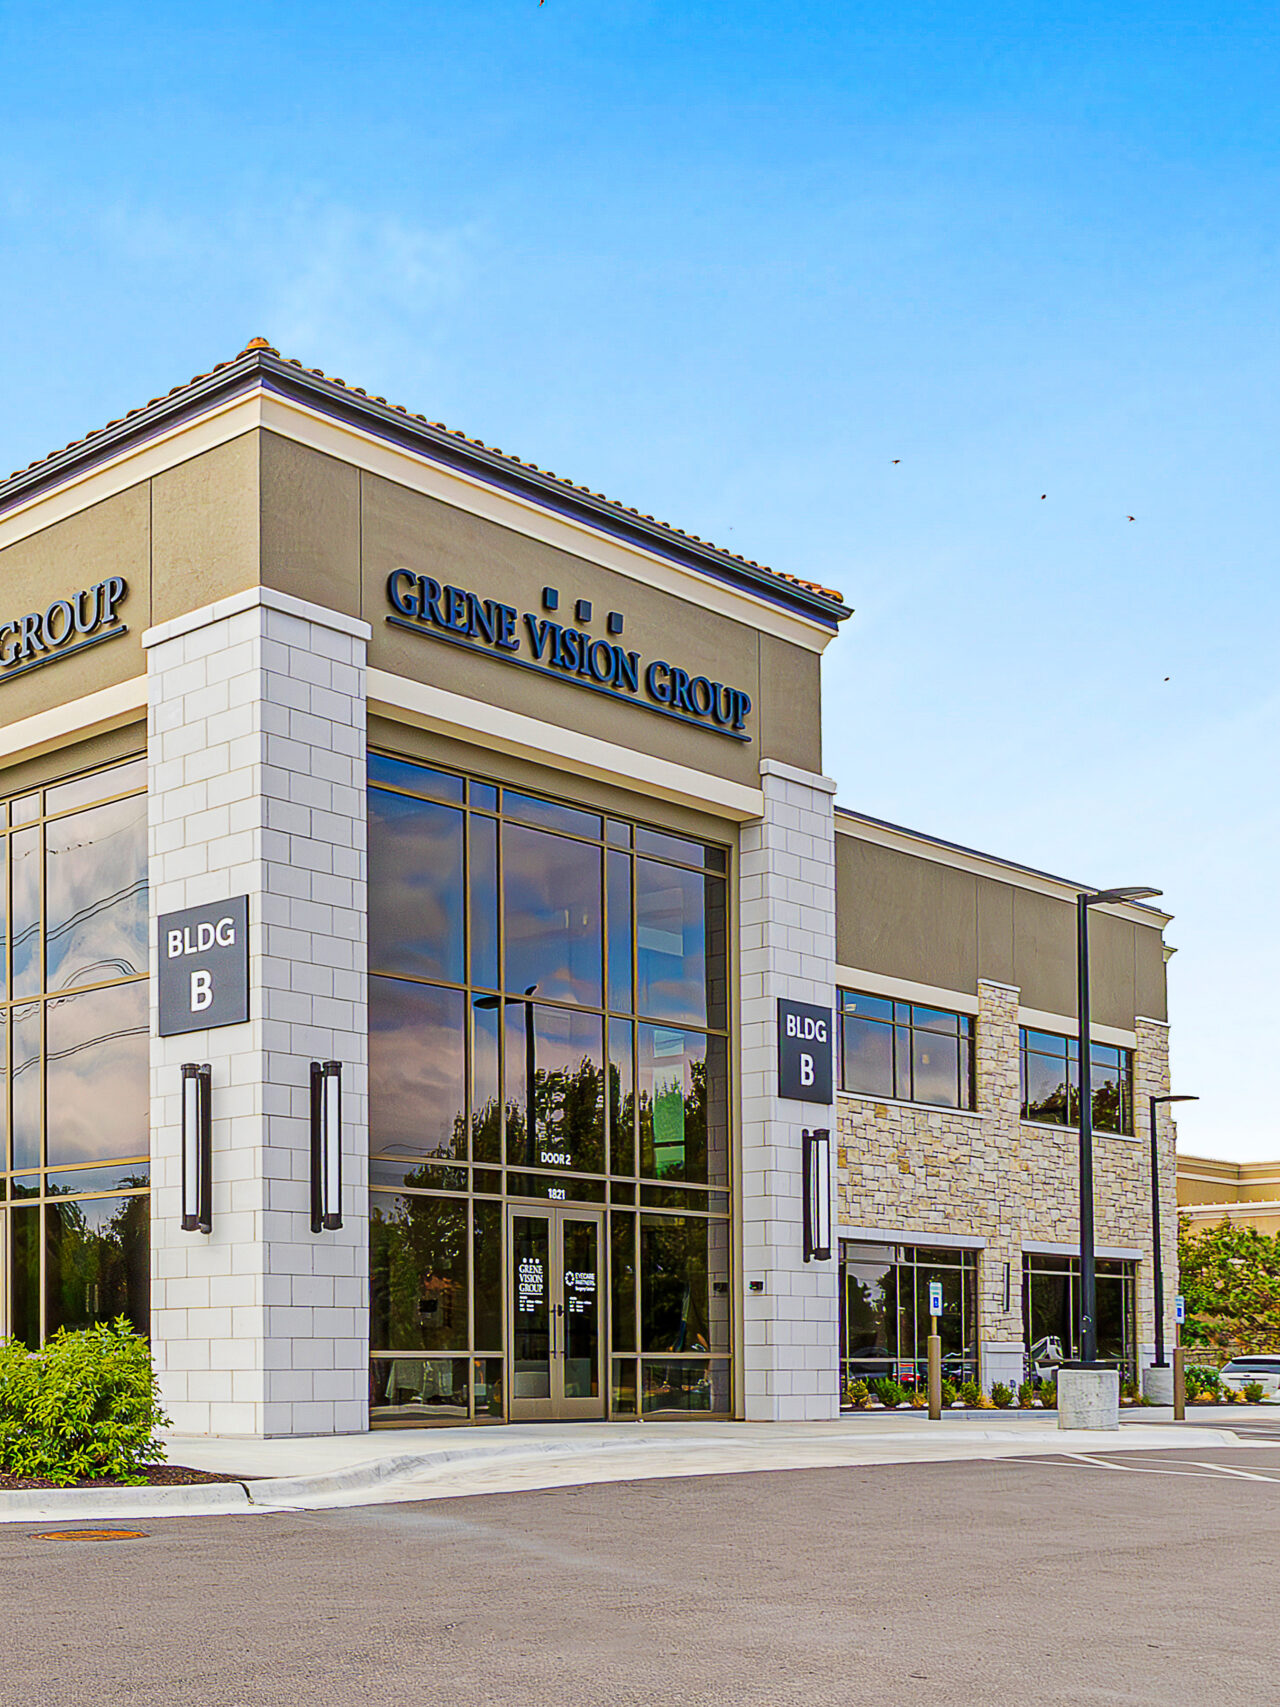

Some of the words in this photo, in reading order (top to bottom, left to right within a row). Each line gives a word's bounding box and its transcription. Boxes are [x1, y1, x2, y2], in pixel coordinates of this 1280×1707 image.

[387, 567, 521, 652] GRENE
[523, 612, 642, 693] VISION
[645, 659, 753, 730] GROUP
[167, 917, 235, 959] BLDG
[190, 969, 213, 1012] B
[786, 1013, 827, 1043] BLDG
[800, 1053, 815, 1086] B
[540, 1151, 564, 1165] DOOR
[565, 1154, 572, 1166] 2
[547, 1188, 566, 1200] 1821
[518, 1264, 544, 1274] GRENE
[518, 1273, 544, 1283] VISION
[518, 1283, 544, 1293] GROUP
